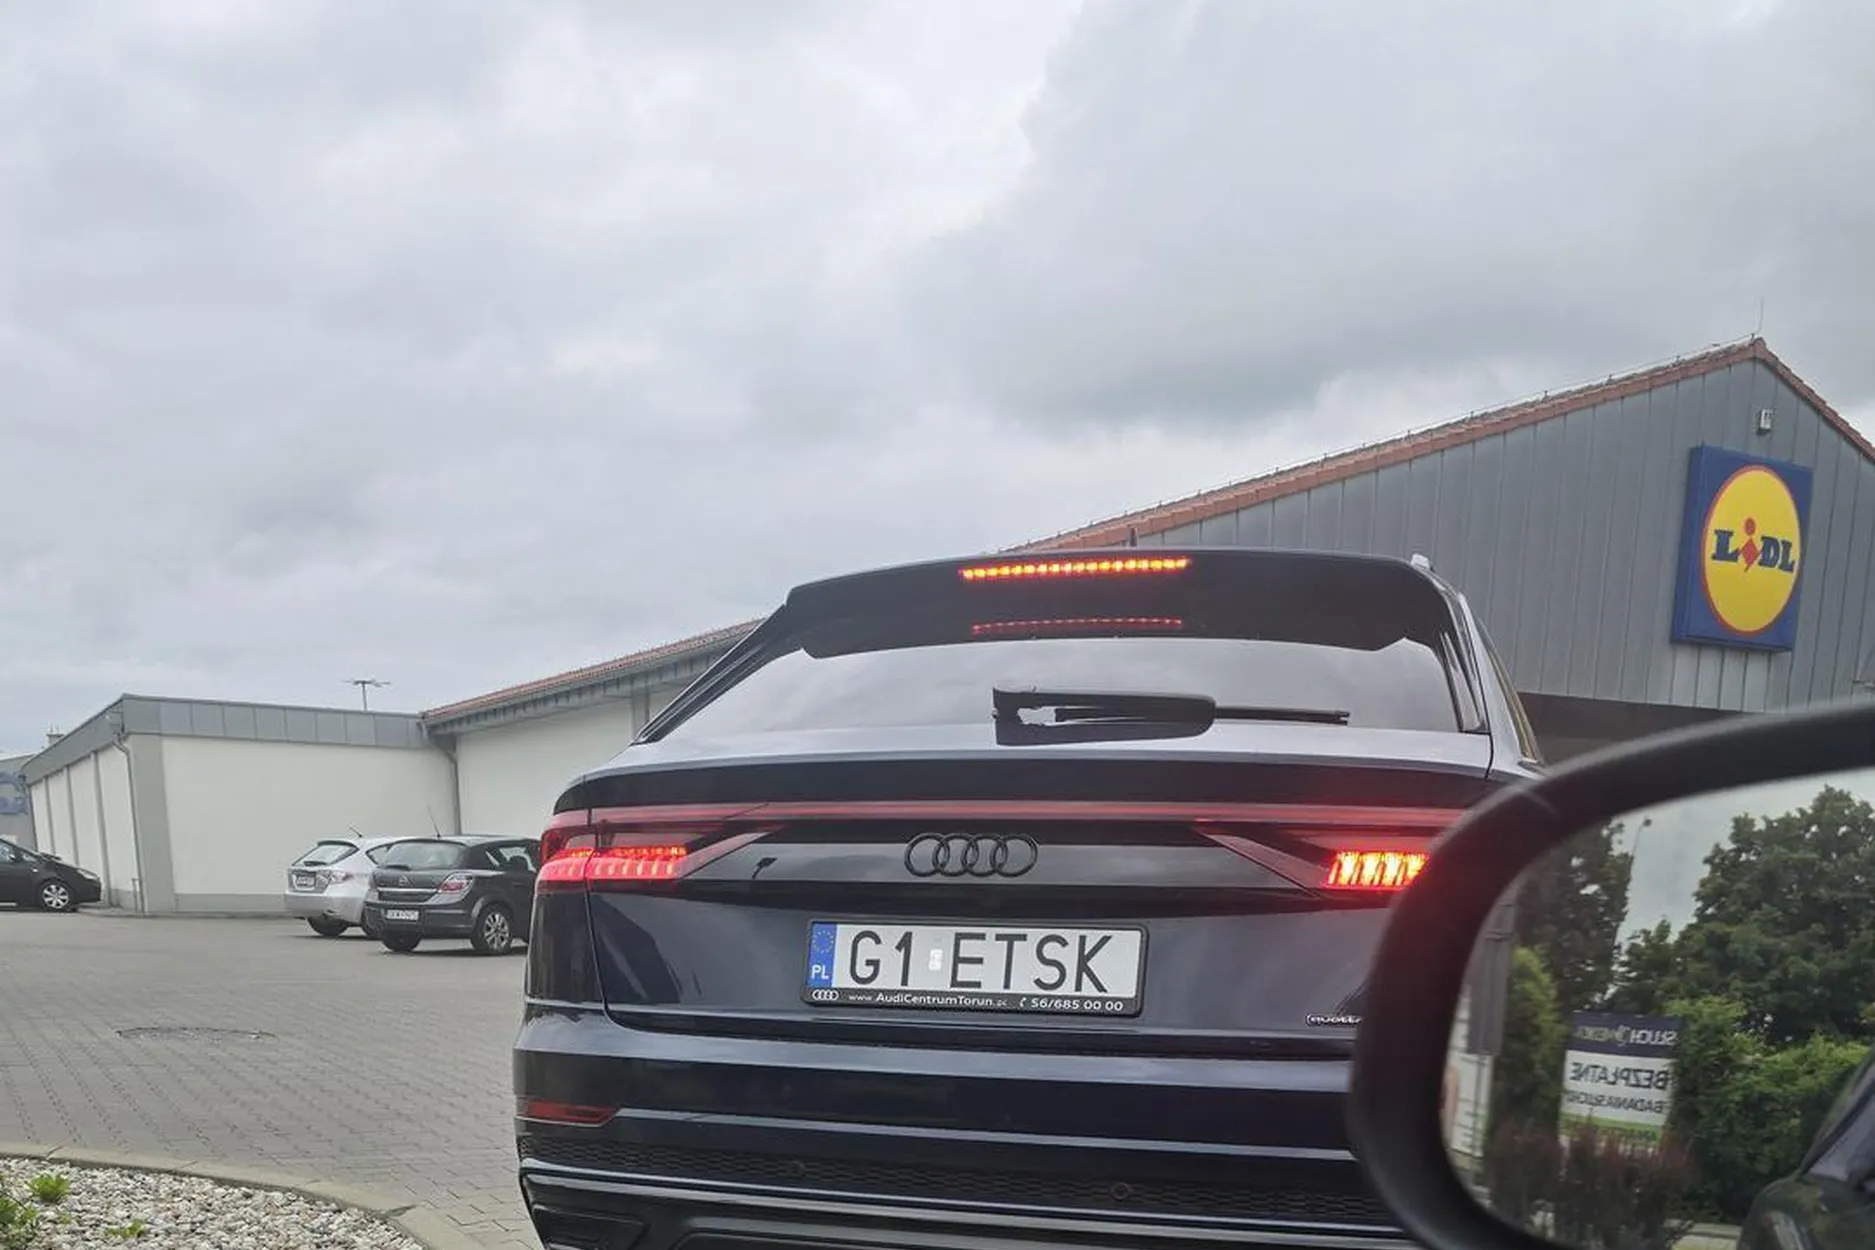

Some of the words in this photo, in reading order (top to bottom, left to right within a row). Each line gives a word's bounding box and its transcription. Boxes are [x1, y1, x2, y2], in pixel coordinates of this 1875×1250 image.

[849, 930, 913, 988] G1
[950, 932, 1113, 994] ETSK
[811, 964, 830, 980] PL
[1031, 997, 1080, 1010] 56/685
[1083, 1000, 1102, 1011] 00
[1105, 1001, 1124, 1012] 00
[1309, 1015, 1361, 1026] quatt
